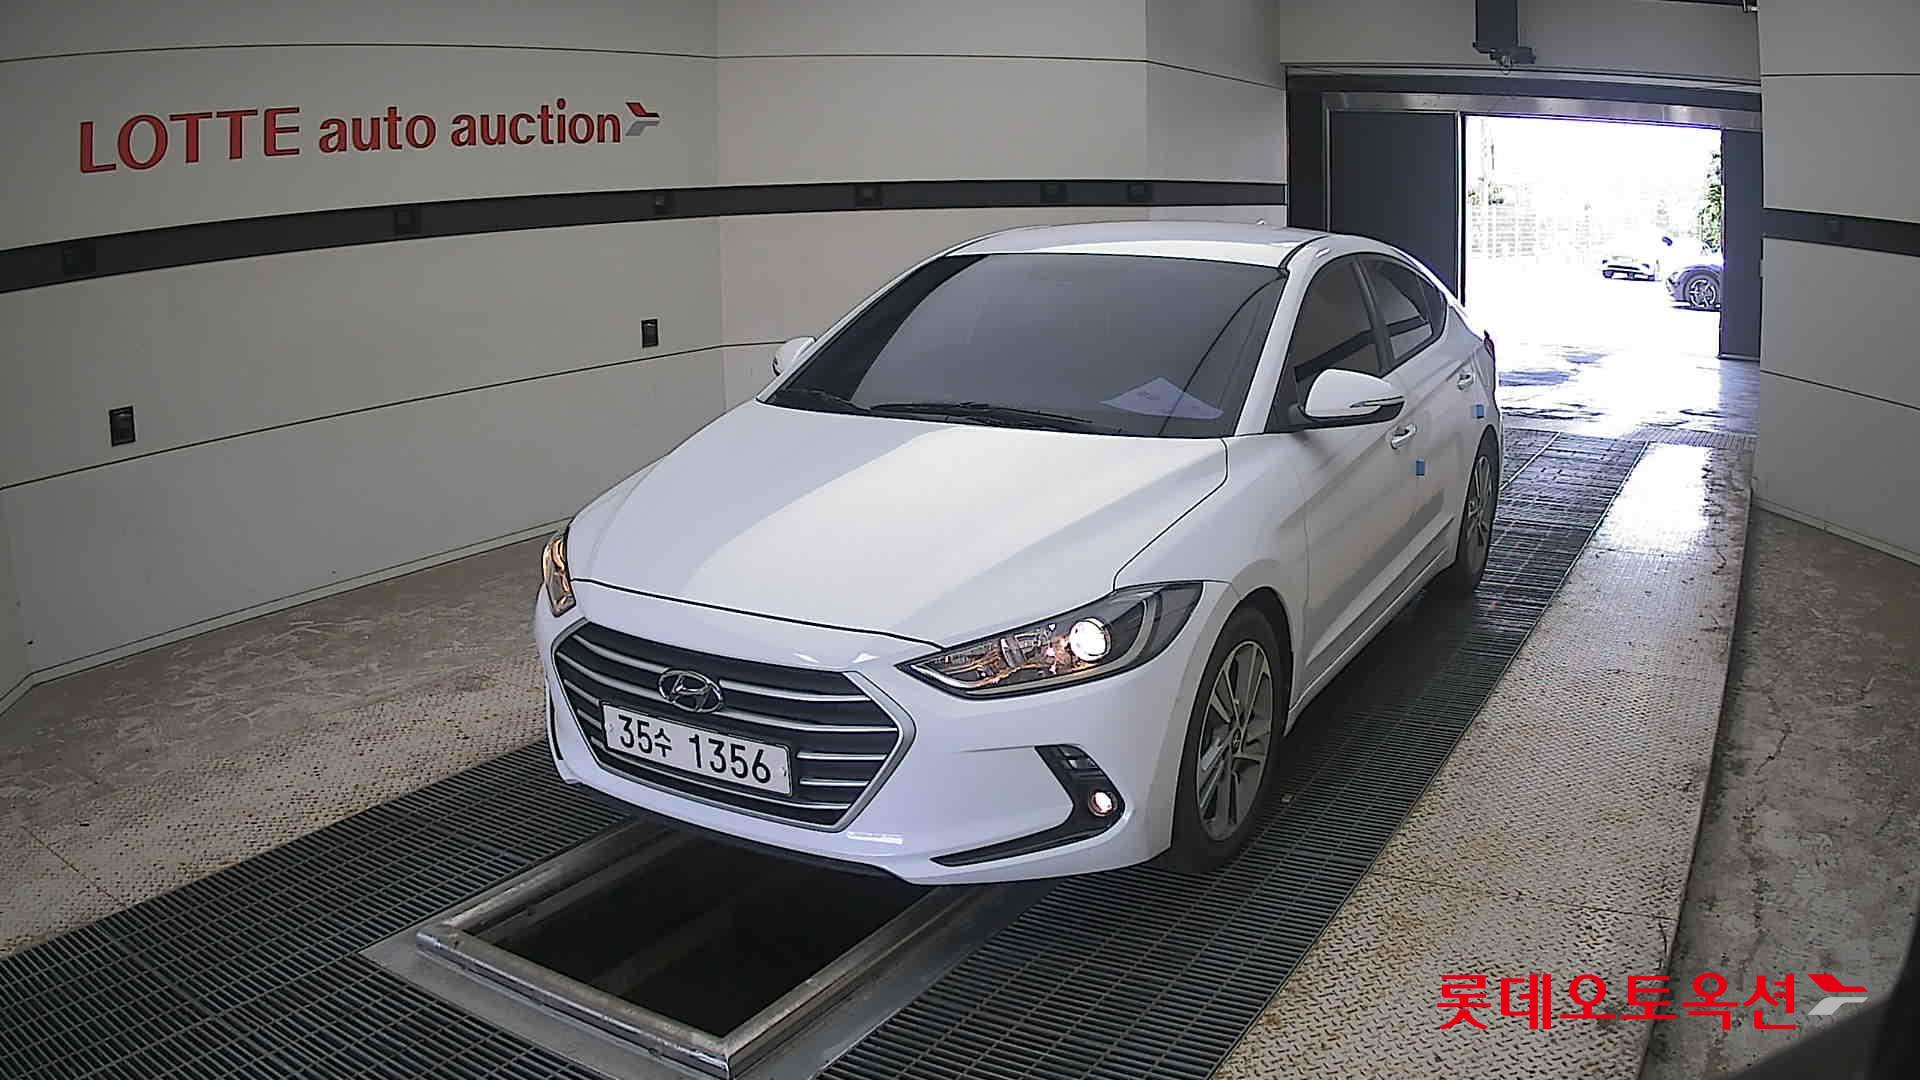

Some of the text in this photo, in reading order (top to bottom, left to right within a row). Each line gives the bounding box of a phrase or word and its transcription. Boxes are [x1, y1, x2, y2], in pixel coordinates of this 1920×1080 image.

[79, 98, 621, 173] LOTTE auto auction
[618, 714, 772, 784] 35수 1356
